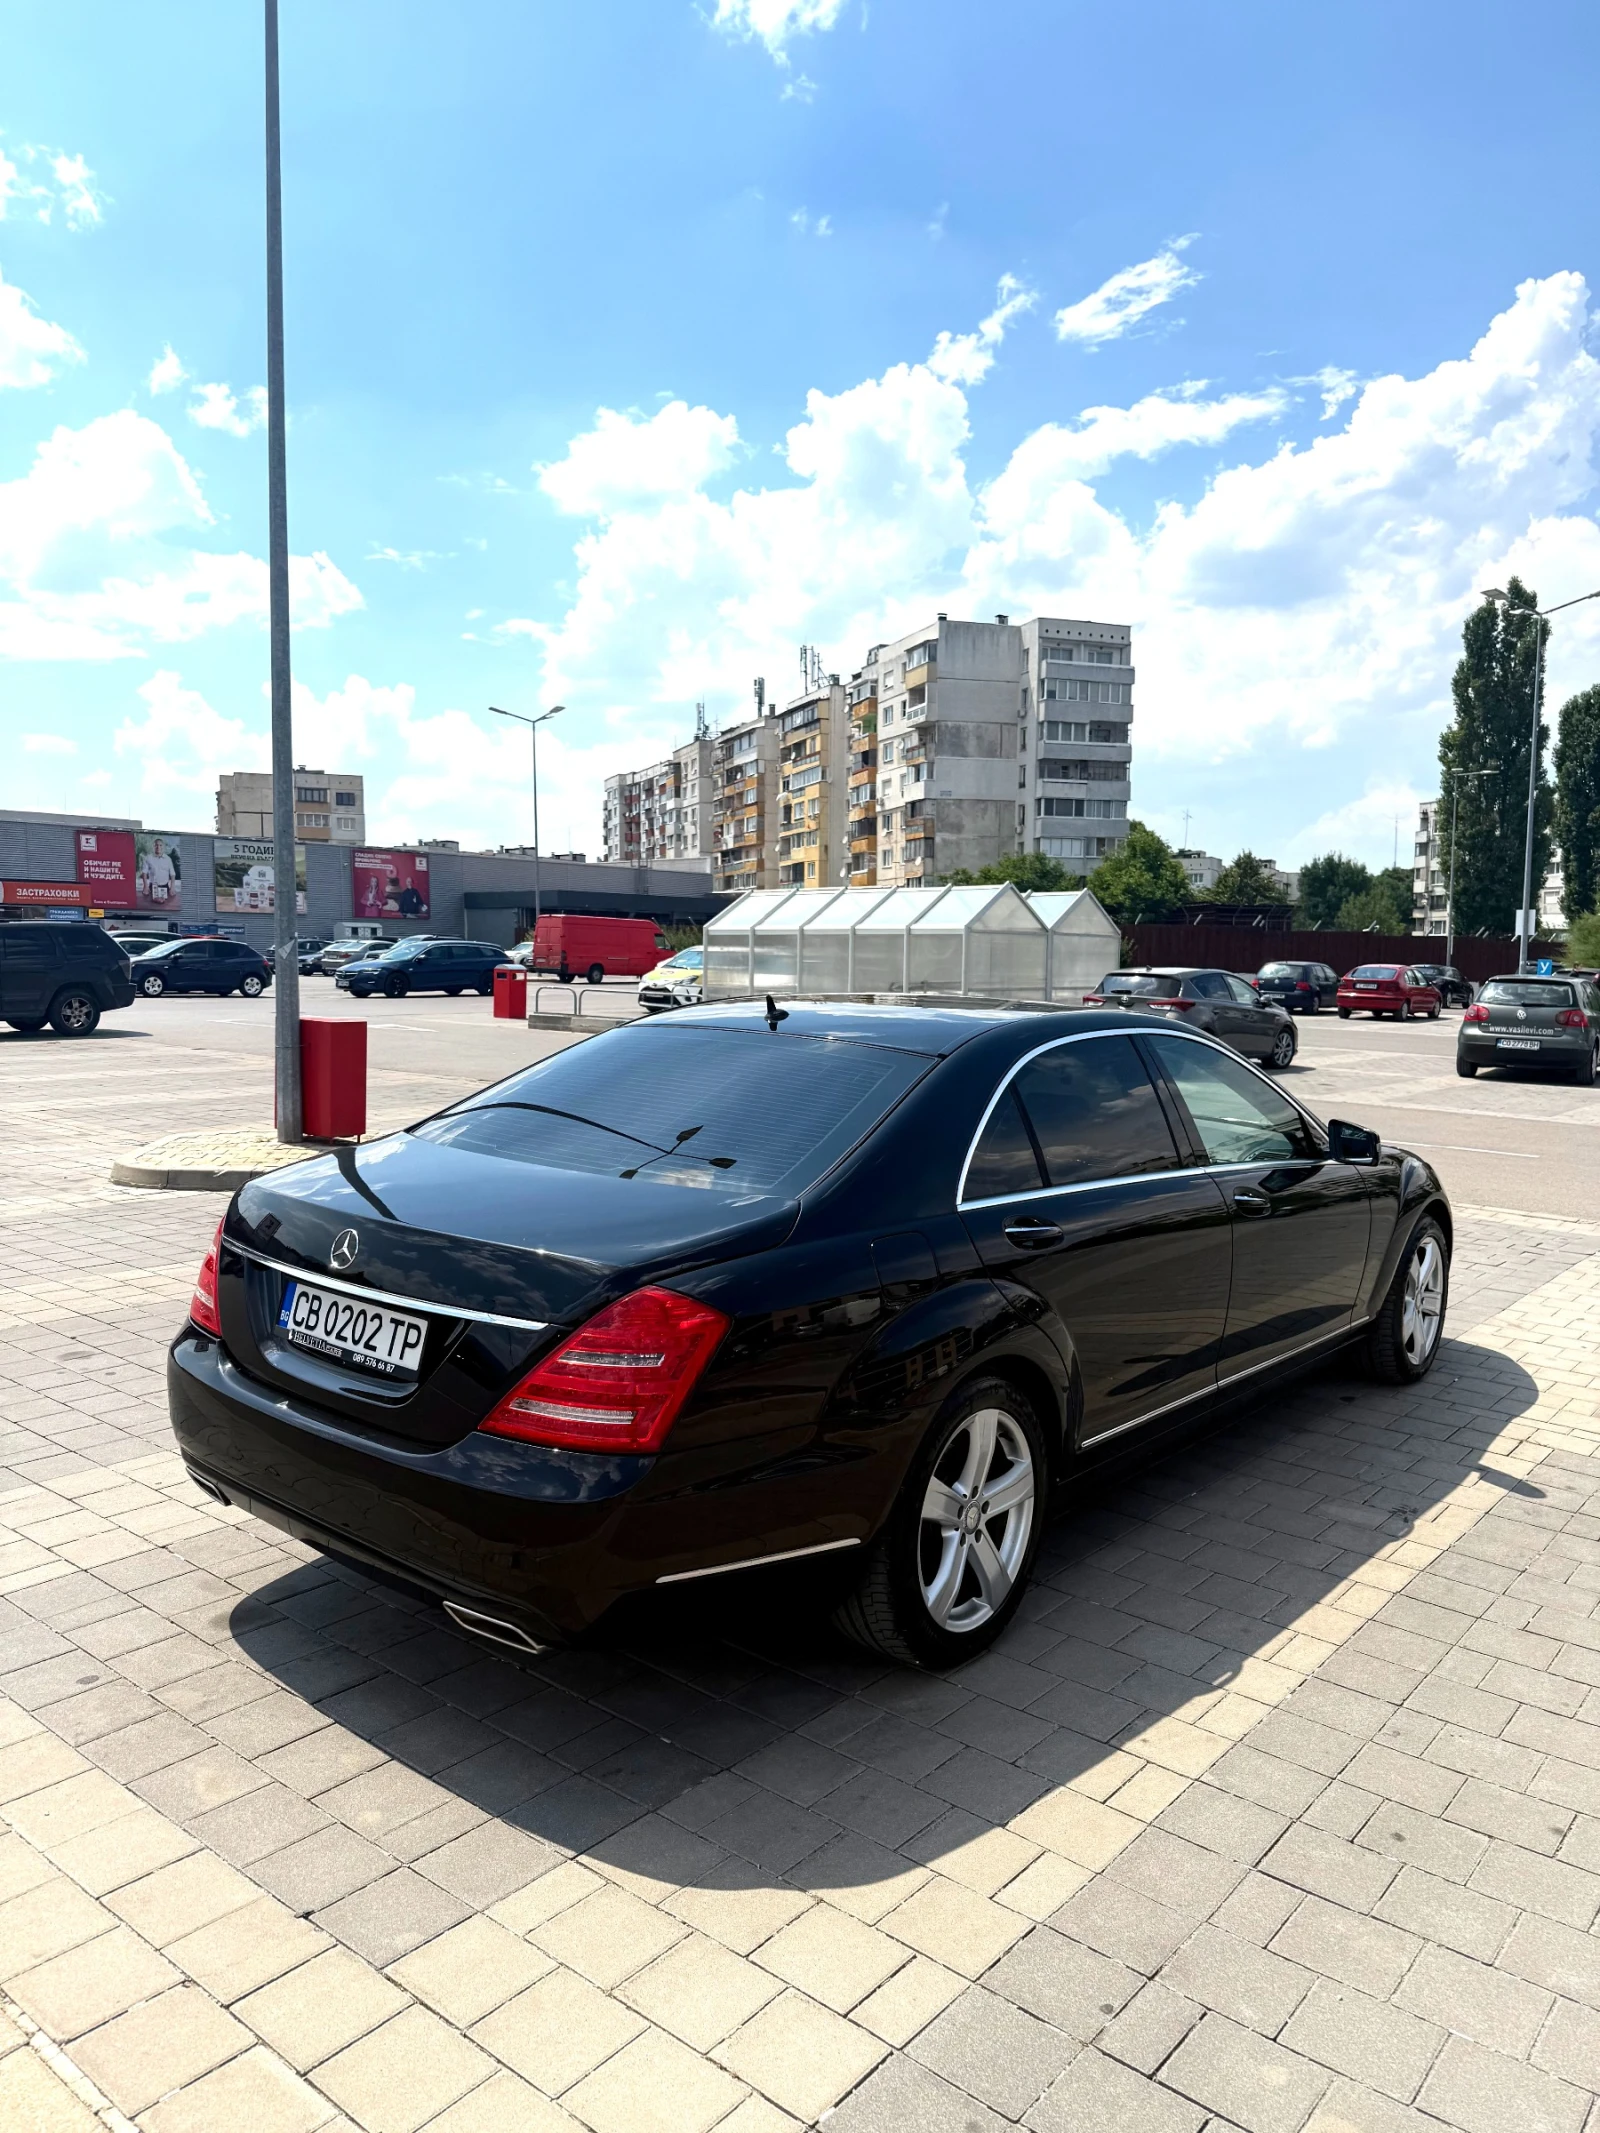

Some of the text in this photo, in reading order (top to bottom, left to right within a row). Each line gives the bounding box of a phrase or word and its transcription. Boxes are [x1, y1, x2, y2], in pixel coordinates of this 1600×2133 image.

[234, 844, 240, 853] 5
[16, 888, 80, 898] ЗАСТРАХОВКИ
[1489, 1025, 1554, 1034] www.vasilevi.com
[280, 1309, 290, 1322] BG
[293, 1291, 422, 1361] CB 0202 TP
[352, 1353, 365, 1364] 089
[365, 1356, 377, 1368] 576
[386, 1362, 396, 1373] 87
